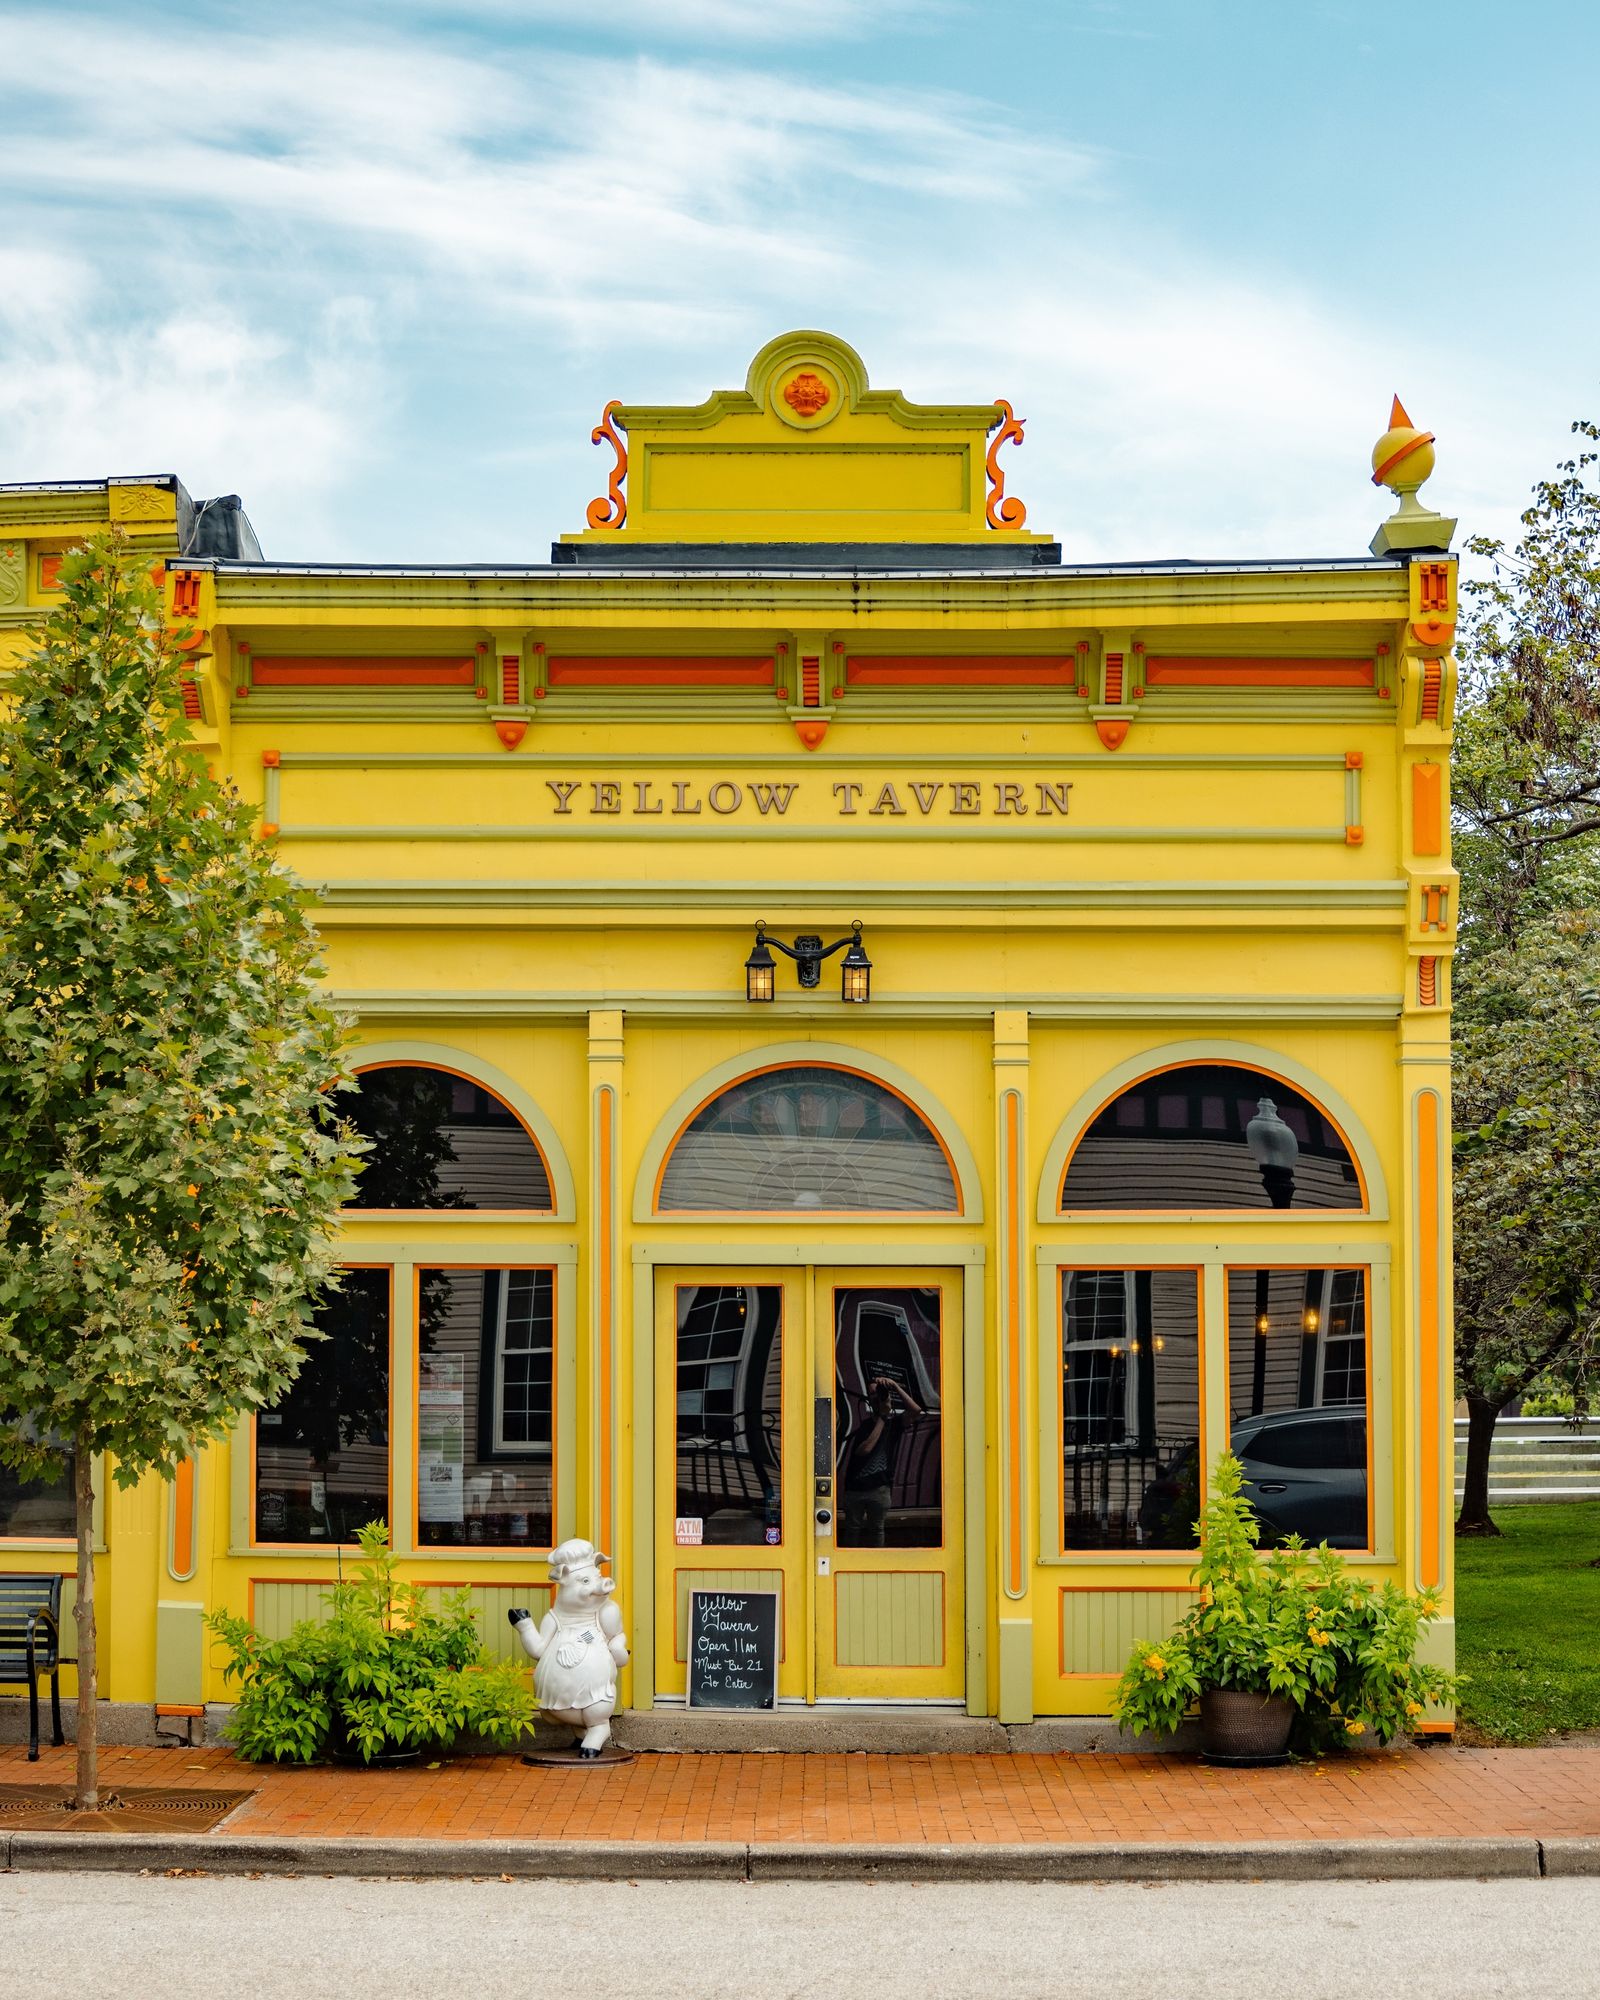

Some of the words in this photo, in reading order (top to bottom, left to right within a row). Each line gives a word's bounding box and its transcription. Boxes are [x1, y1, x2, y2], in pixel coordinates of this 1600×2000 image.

[546, 781, 799, 815] YELLOW
[833, 781, 1073, 815] TAVERN
[677, 1519, 702, 1534] ATM
[698, 1595, 747, 1623] Yellow
[704, 1611, 759, 1632] Tavern
[698, 1636, 730, 1655] Open
[694, 1656, 722, 1673] Must
[724, 1659, 743, 1671] Be
[747, 1659, 764, 1671] 21
[701, 1674, 719, 1689] To
[725, 1675, 753, 1689] Enter
